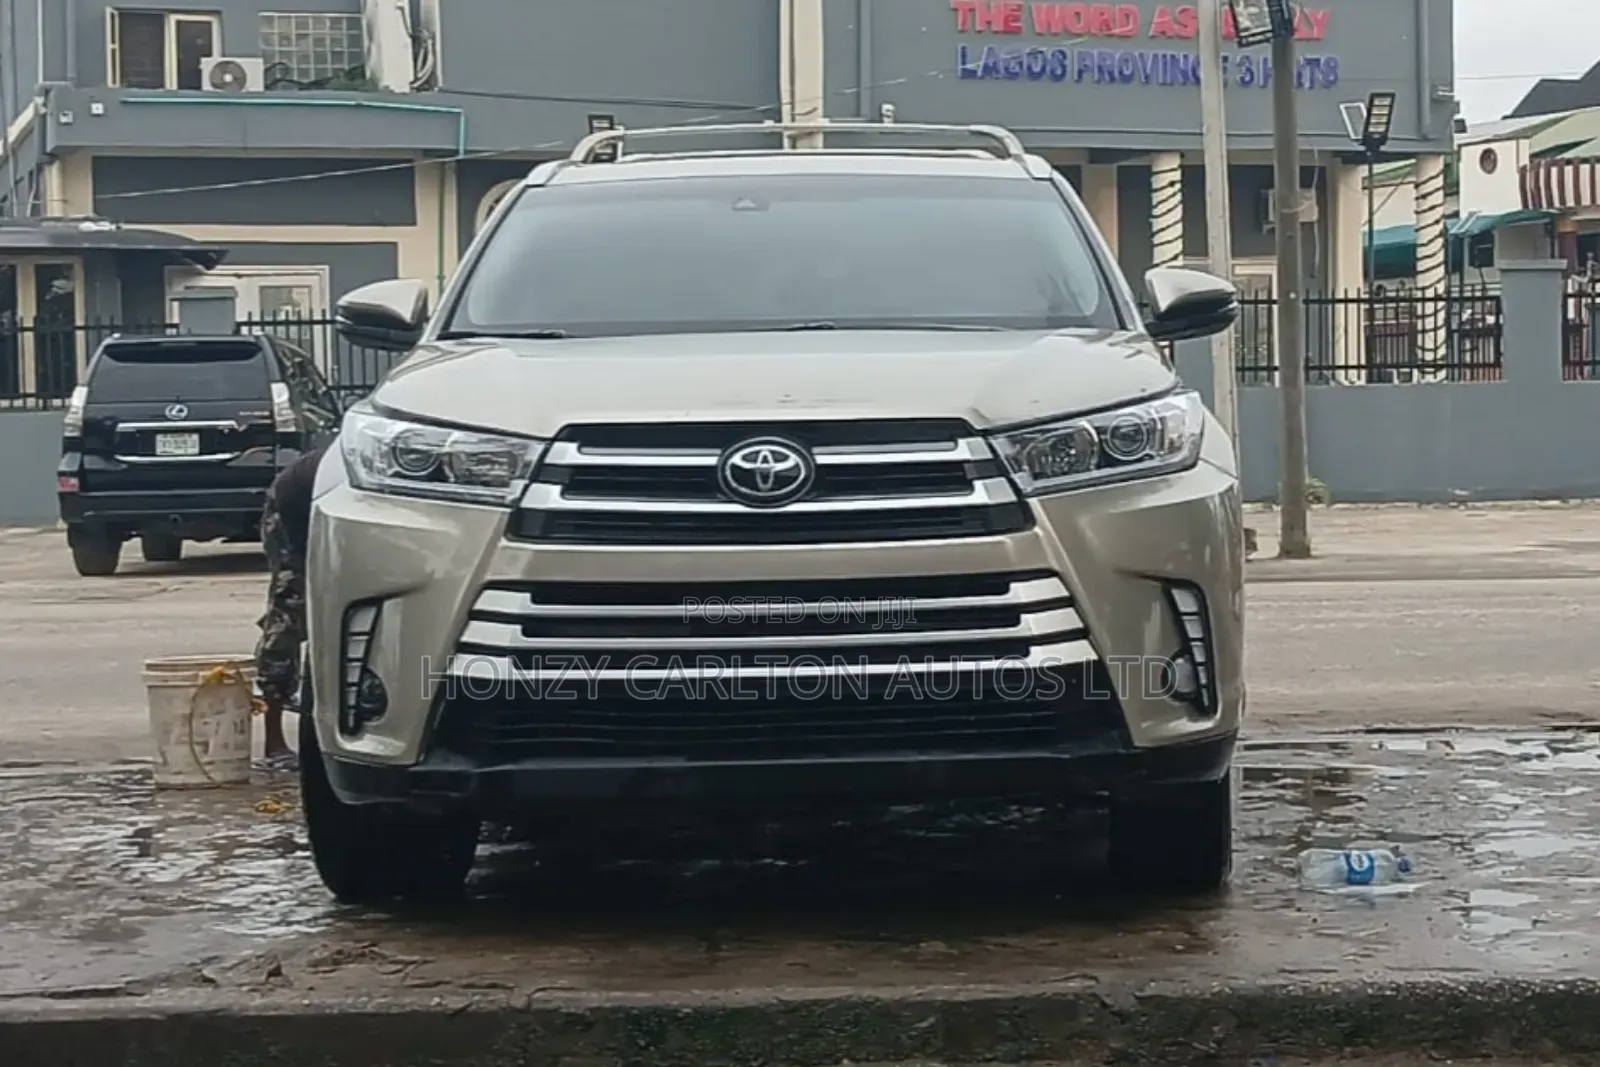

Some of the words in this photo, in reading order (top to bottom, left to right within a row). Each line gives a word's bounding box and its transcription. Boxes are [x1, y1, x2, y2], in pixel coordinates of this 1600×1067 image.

[951, 1, 1024, 34] THE
[1032, 3, 1139, 37] WORD
[1149, 5, 1331, 40] ASLY
[958, 44, 1068, 80] LAGOS
[1235, 55, 1254, 89] 3
[1259, 56, 1339, 90] HTS
